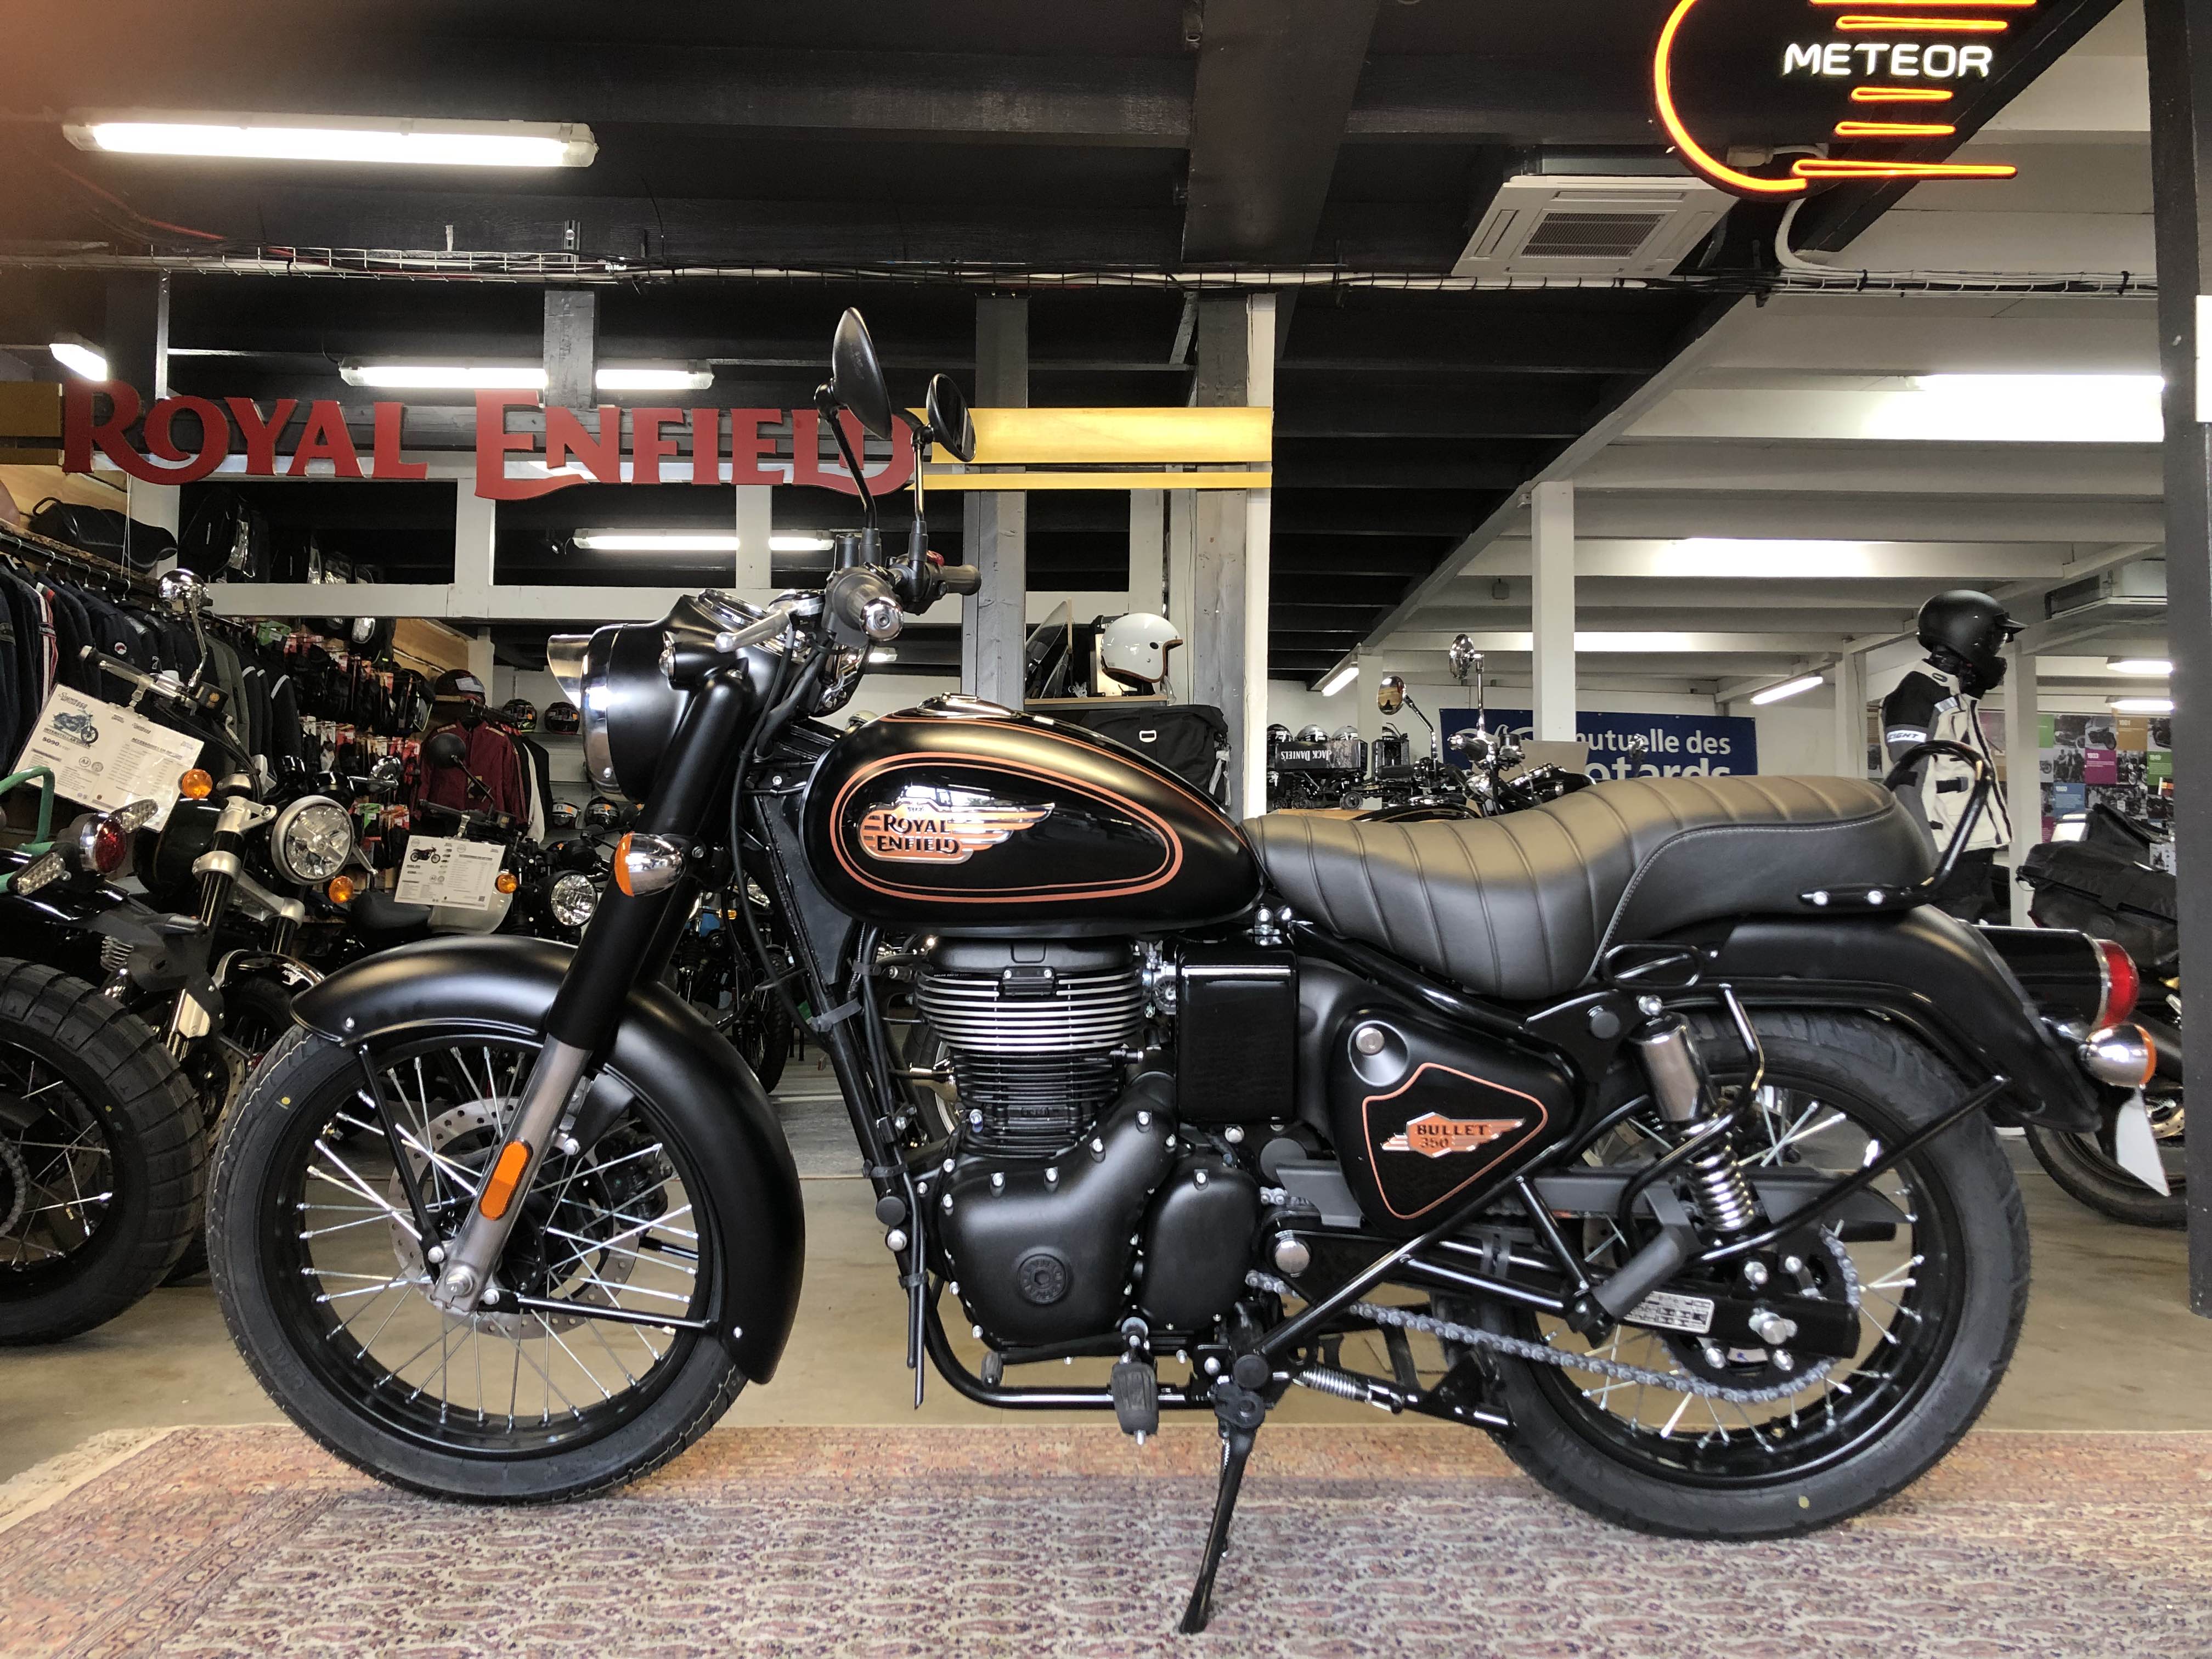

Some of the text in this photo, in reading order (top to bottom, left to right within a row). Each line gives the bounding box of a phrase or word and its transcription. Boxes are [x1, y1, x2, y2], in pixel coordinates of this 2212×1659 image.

[1782, 43, 1993, 78] METEOR
[61, 379, 915, 500] ROYAL ENFIELD
[1686, 730, 1731, 754] des
[1280, 750, 1332, 761] JACK DANIEL'S
[883, 813, 950, 834] ROYAL
[877, 835, 960, 854] ENFIELD
[1417, 1124, 1488, 1136] BULLET
[1420, 1137, 1449, 1148] 350
